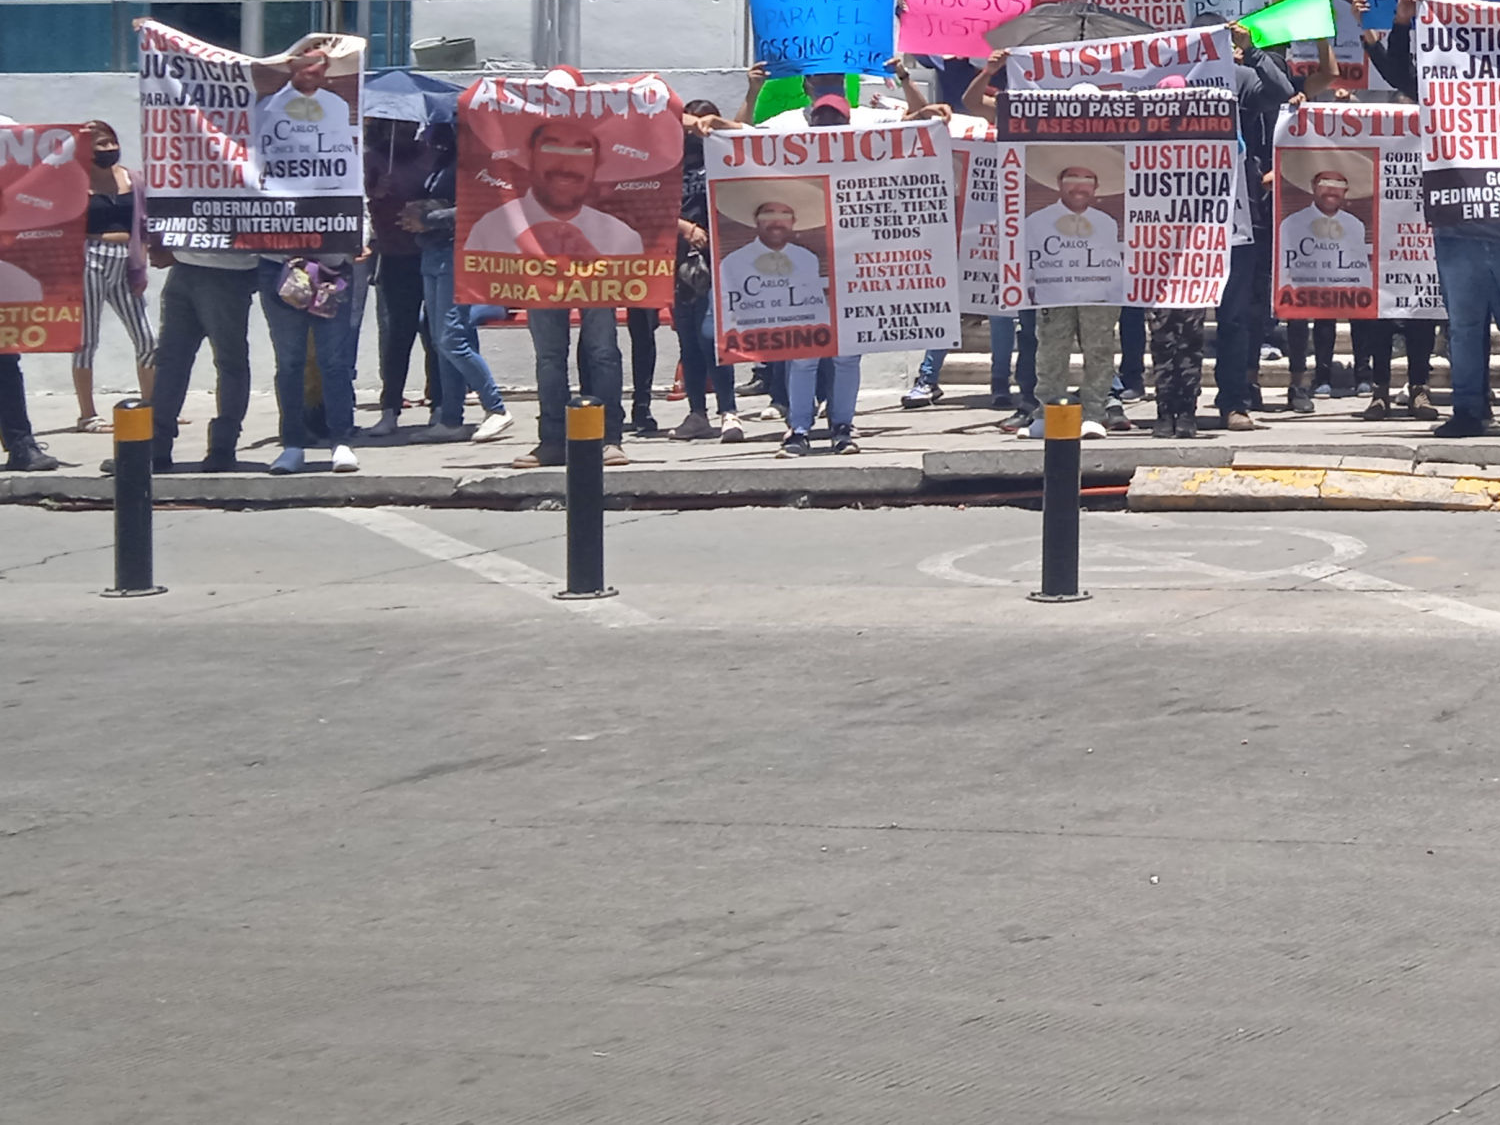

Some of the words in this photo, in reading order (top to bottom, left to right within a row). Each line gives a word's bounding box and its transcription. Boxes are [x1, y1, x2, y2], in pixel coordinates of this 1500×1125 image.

[1023, 31, 1221, 83] JUSTICIA
[140, 54, 248, 84] JUSTICIA
[1422, 65, 1459, 80] PARA
[140, 91, 171, 106] PARA
[174, 82, 250, 109] JAIRO
[468, 77, 671, 119] ASESINO
[1010, 102, 1050, 118] QUE
[1056, 101, 1082, 117] NO
[1089, 101, 1136, 117] PASE
[1143, 101, 1181, 117] POR
[1186, 101, 1231, 117] ALTO
[142, 108, 251, 135] JUSTICIA
[1009, 119, 1030, 134] EL
[1037, 118, 1142, 134] ASESINATO
[1147, 118, 1172, 133] DE
[1177, 116, 1232, 132] JAIRO
[143, 136, 249, 162] JUSTICIA
[722, 126, 938, 168] JUSTICIA
[1129, 144, 1232, 170] JUSTICIA
[262, 158, 348, 179] ASESINO
[836, 191, 851, 204] SI
[857, 190, 875, 202] LA
[878, 186, 949, 200] JUSTICIA
[1128, 172, 1231, 198] JUSTICIA
[1385, 189, 1413, 200] QUE
[192, 201, 296, 217] GOBERNADOR
[902, 199, 948, 214] TIENE
[1129, 210, 1161, 223] PARA
[1164, 199, 1229, 224] JAIRO
[1463, 202, 1487, 220] EN
[212, 217, 231, 233] SU
[237, 212, 358, 232] INTERVENCIÓN
[838, 216, 871, 230] QUE
[874, 215, 903, 227] SER
[907, 212, 949, 225] PARA
[1001, 148, 1023, 308] ASESINO
[162, 232, 185, 247] EN
[190, 233, 231, 249] ESTE
[871, 228, 921, 241] TODOS
[1128, 225, 1227, 251] JUSTICIA
[463, 255, 557, 277] EXIJIMOS
[563, 258, 675, 277] JUSTICIA!
[854, 249, 933, 265] EXIJIMOS
[1127, 252, 1225, 278] JUSTICIA
[1389, 250, 1431, 261] PARA
[856, 264, 932, 279] JUSTICIA
[489, 282, 541, 301] PARA
[548, 278, 648, 302] JAIRO
[847, 279, 892, 294] PARA
[896, 276, 947, 291] JAIRO
[1127, 279, 1219, 305] JUSTICIA
[844, 303, 886, 319] PENA
[890, 301, 952, 317] MAXIMA
[1279, 289, 1373, 310] ASESINO
[877, 315, 920, 330] PARA
[724, 327, 831, 353] ASESINO
[857, 331, 877, 344] EL
[879, 327, 946, 342] ASESINO
